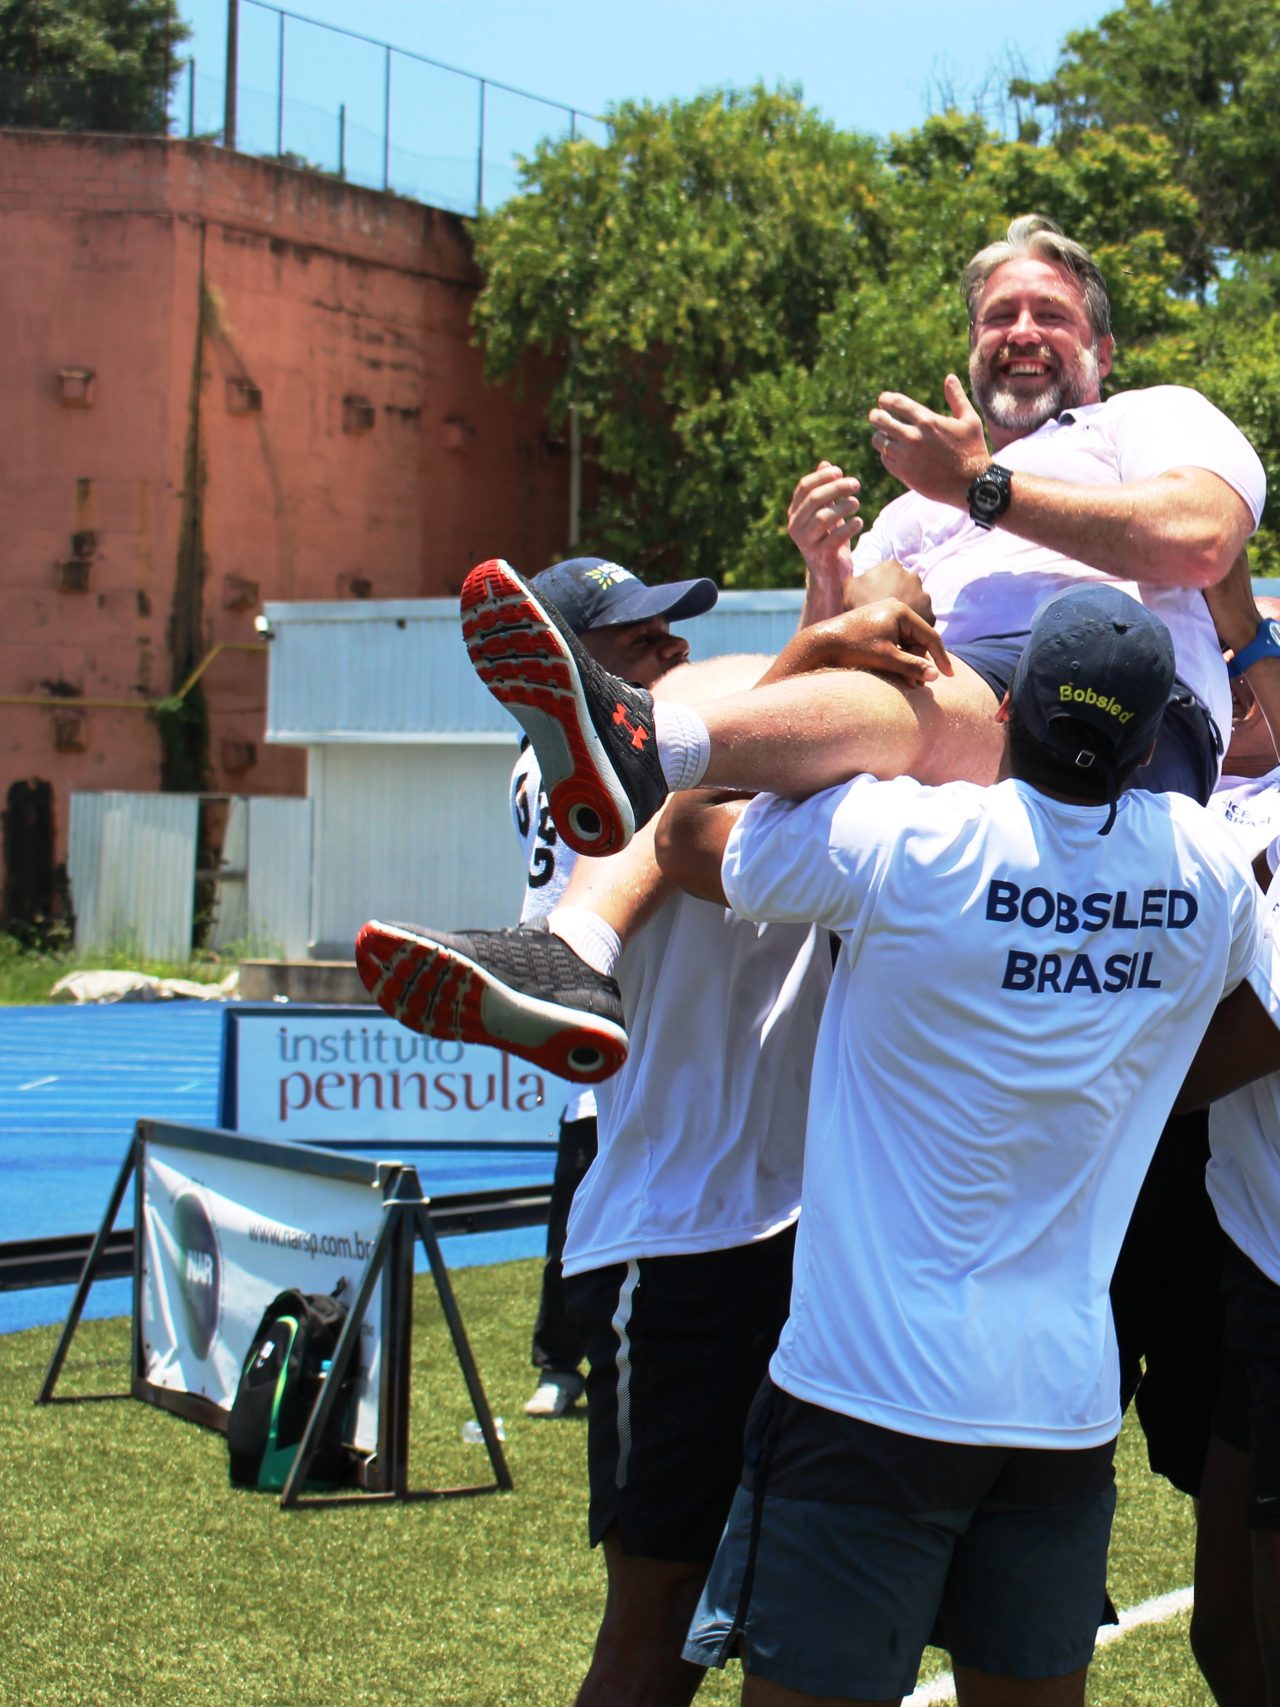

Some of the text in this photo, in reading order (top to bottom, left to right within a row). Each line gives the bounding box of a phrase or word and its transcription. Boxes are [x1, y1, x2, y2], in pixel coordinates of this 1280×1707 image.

[1059, 684, 1134, 724] Bobsled
[985, 879, 1198, 934] BOBSLED
[1001, 949, 1162, 994] BRASIL
[278, 1027, 465, 1064] instituto
[186, 1249, 214, 1287] NAR
